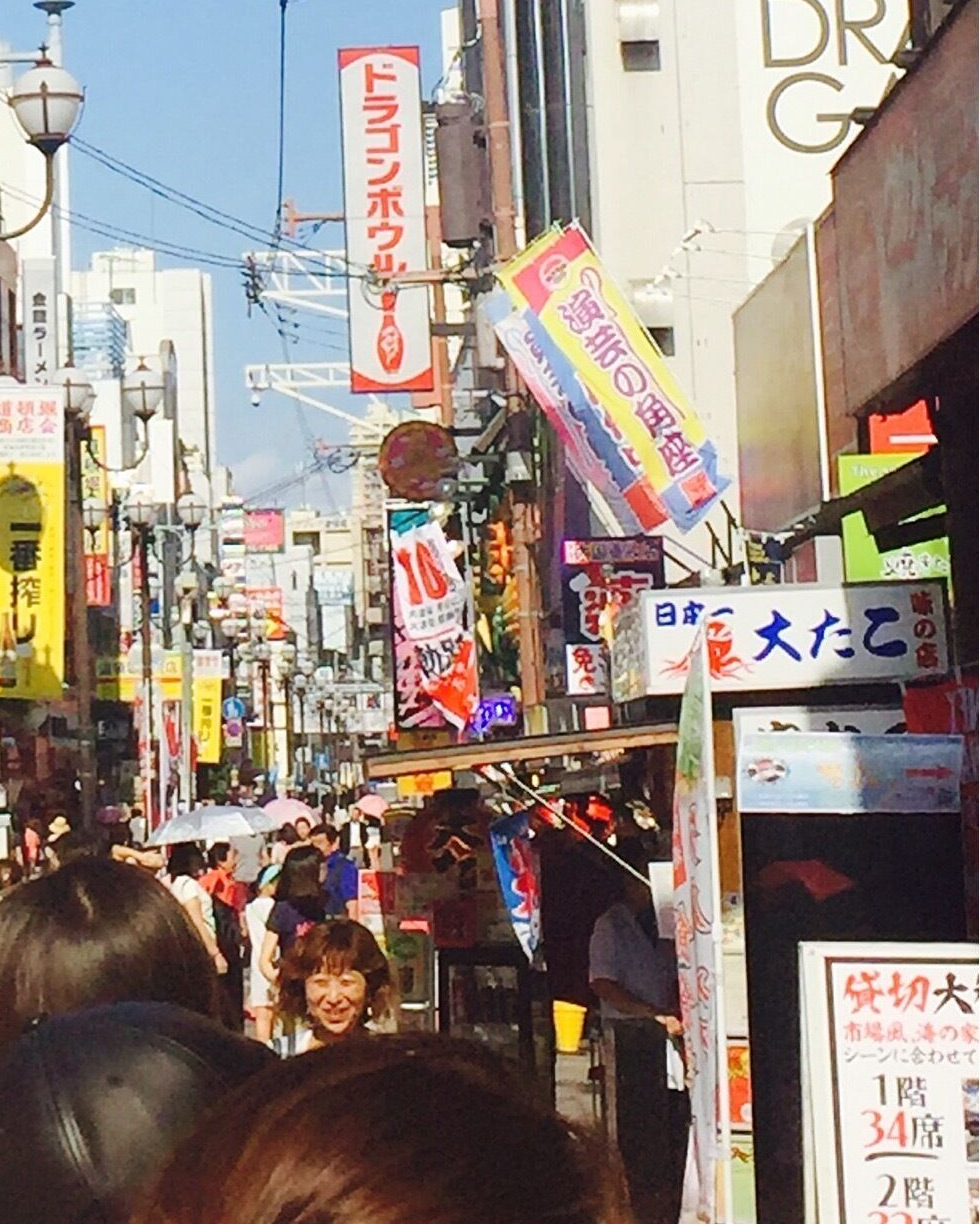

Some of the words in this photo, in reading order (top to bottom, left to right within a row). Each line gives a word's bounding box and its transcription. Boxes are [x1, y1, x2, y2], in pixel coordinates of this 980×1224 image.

[362, 62, 408, 274] ドラゴンボウル
[32, 292, 48, 385] 金龍ラーメ
[9, 521, 42, 645] 一番搾り
[753, 606, 909, 663] 大たこ
[843, 970, 978, 1015] 貸切大
[843, 1045, 977, 1065] シーンに合わせて
[872, 1073, 928, 1108] 1階
[861, 1109, 945, 1150] 34席
[876, 1173, 935, 1210] 2階
